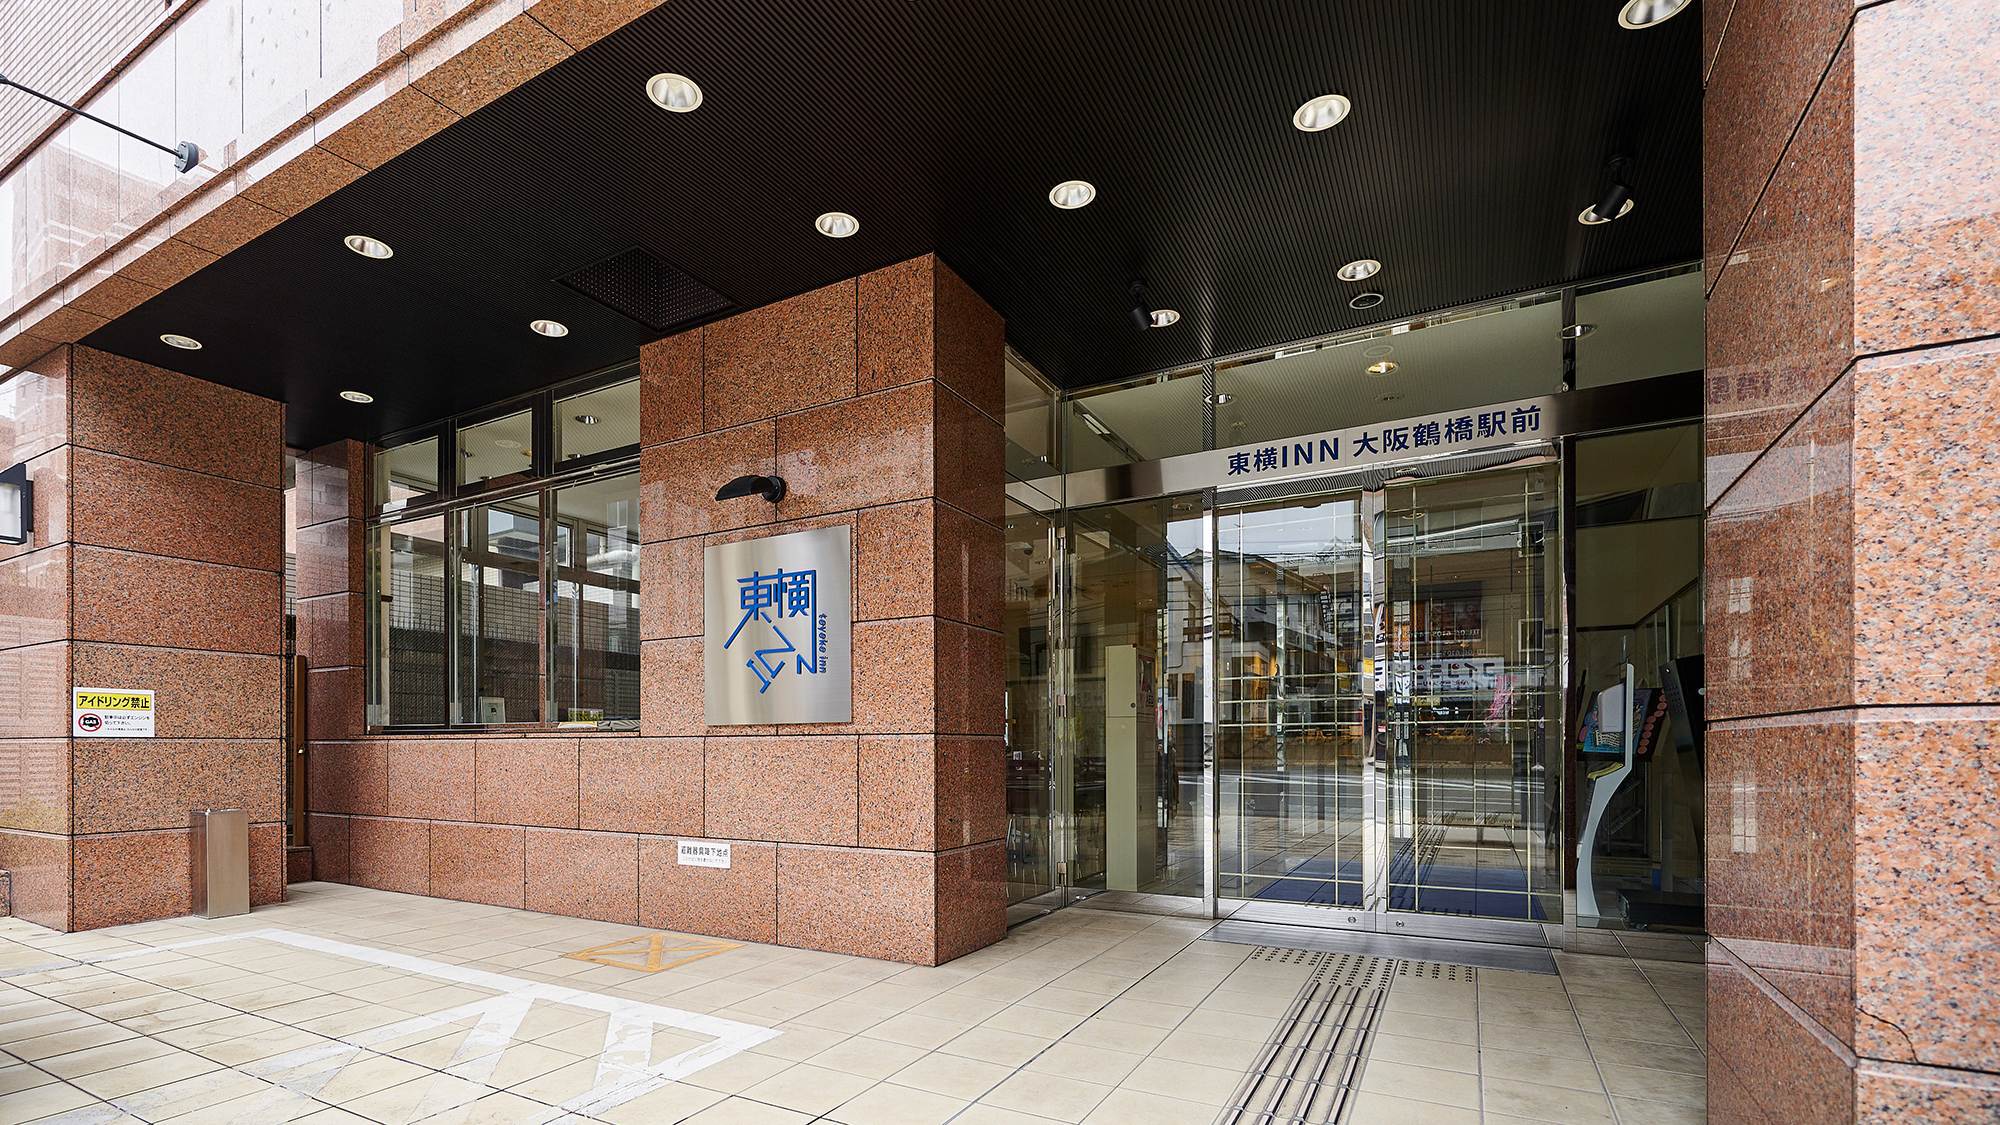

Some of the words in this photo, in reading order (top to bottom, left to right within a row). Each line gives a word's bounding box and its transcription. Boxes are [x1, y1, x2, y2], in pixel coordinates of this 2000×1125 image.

[1227, 437, 1339, 476] 東横INN
[1353, 405, 1541, 457] 大阪鶴橋駅前
[817, 612, 828, 654] toyoko
[818, 656, 828, 674] inn
[78, 695, 150, 709] アイドリング禁止
